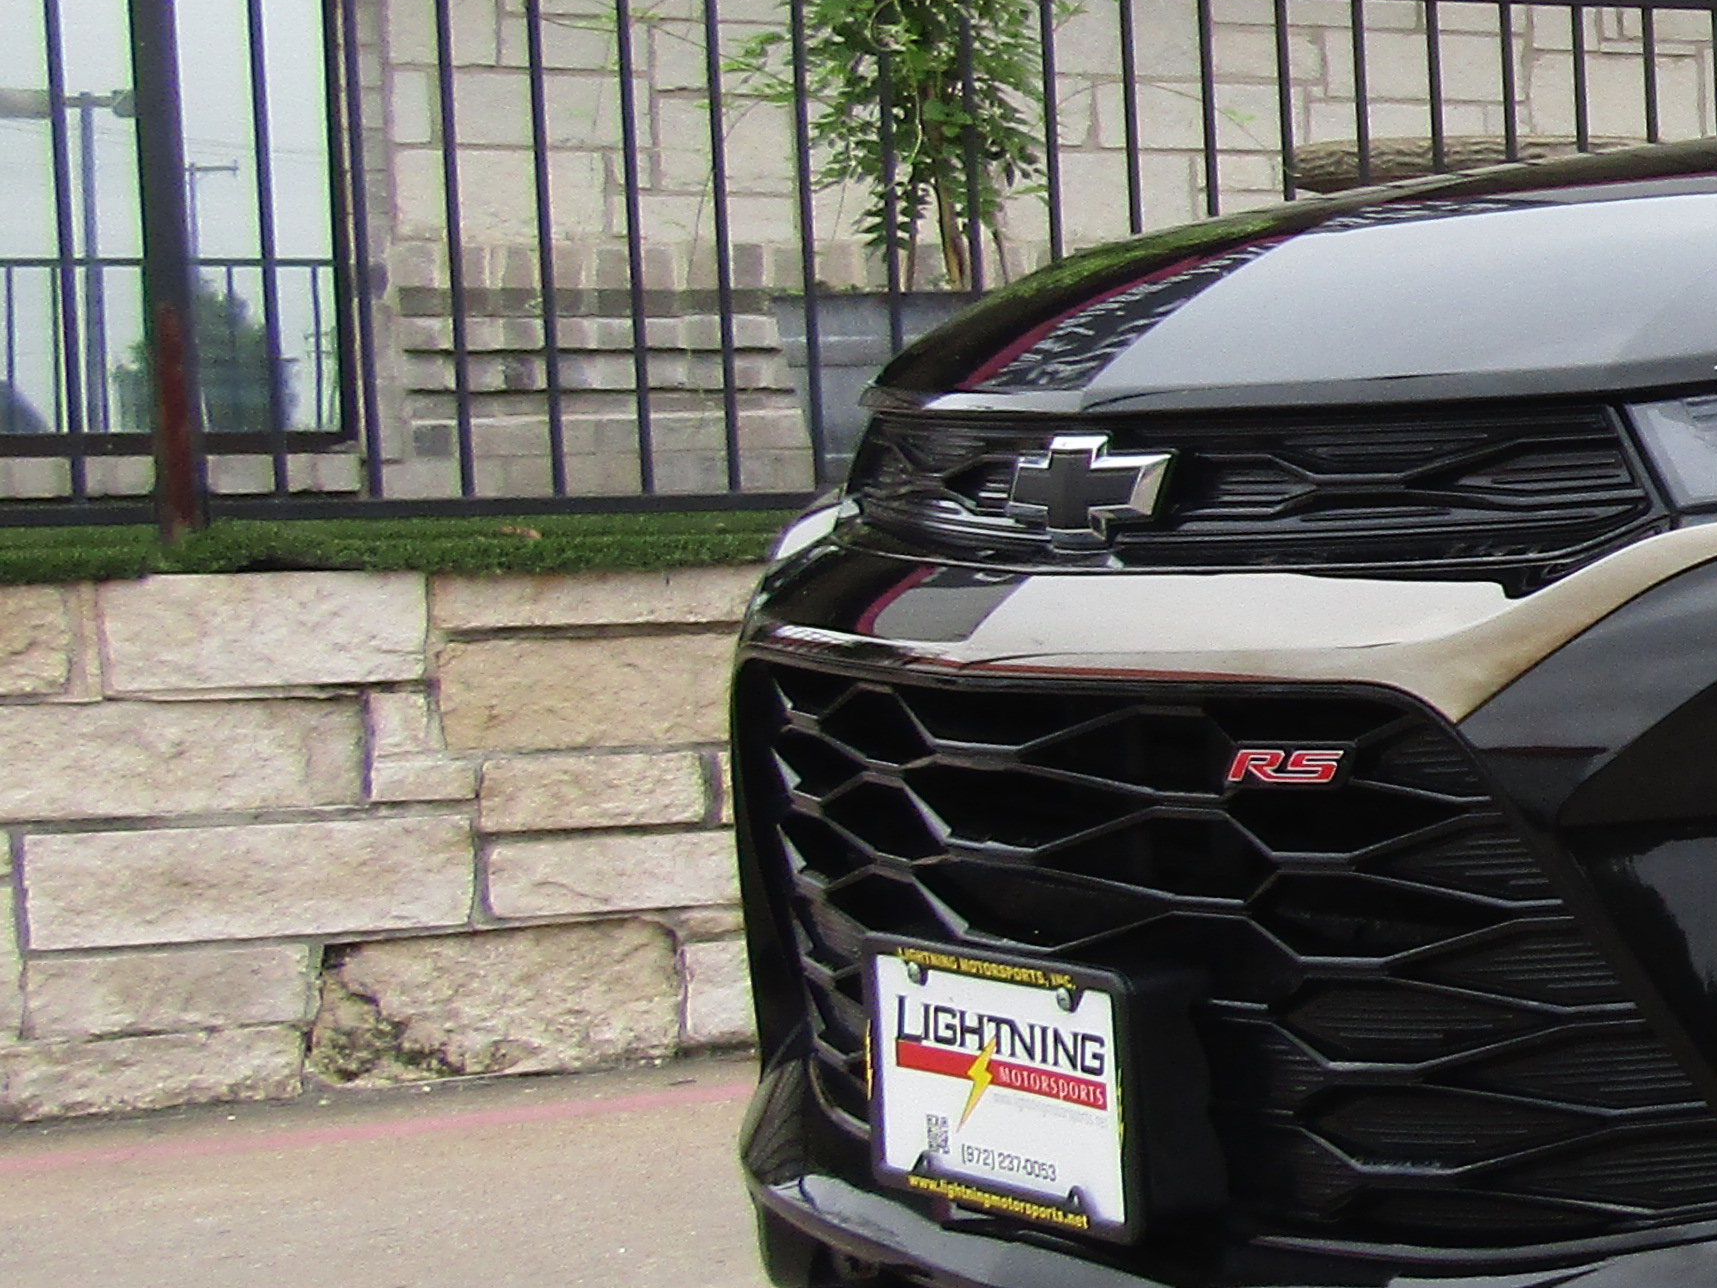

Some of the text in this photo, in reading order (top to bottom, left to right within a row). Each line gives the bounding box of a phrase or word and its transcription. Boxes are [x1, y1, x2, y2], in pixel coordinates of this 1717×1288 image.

[1227, 749, 1345, 783] RS
[896, 994, 1106, 1077] LIGHTNING
[998, 1065, 1105, 1105] MOTORSPORTS
[961, 1143, 1057, 1182] (972) 237-0053
[907, 1174, 1090, 1229] www.lightningmotorsports.net
